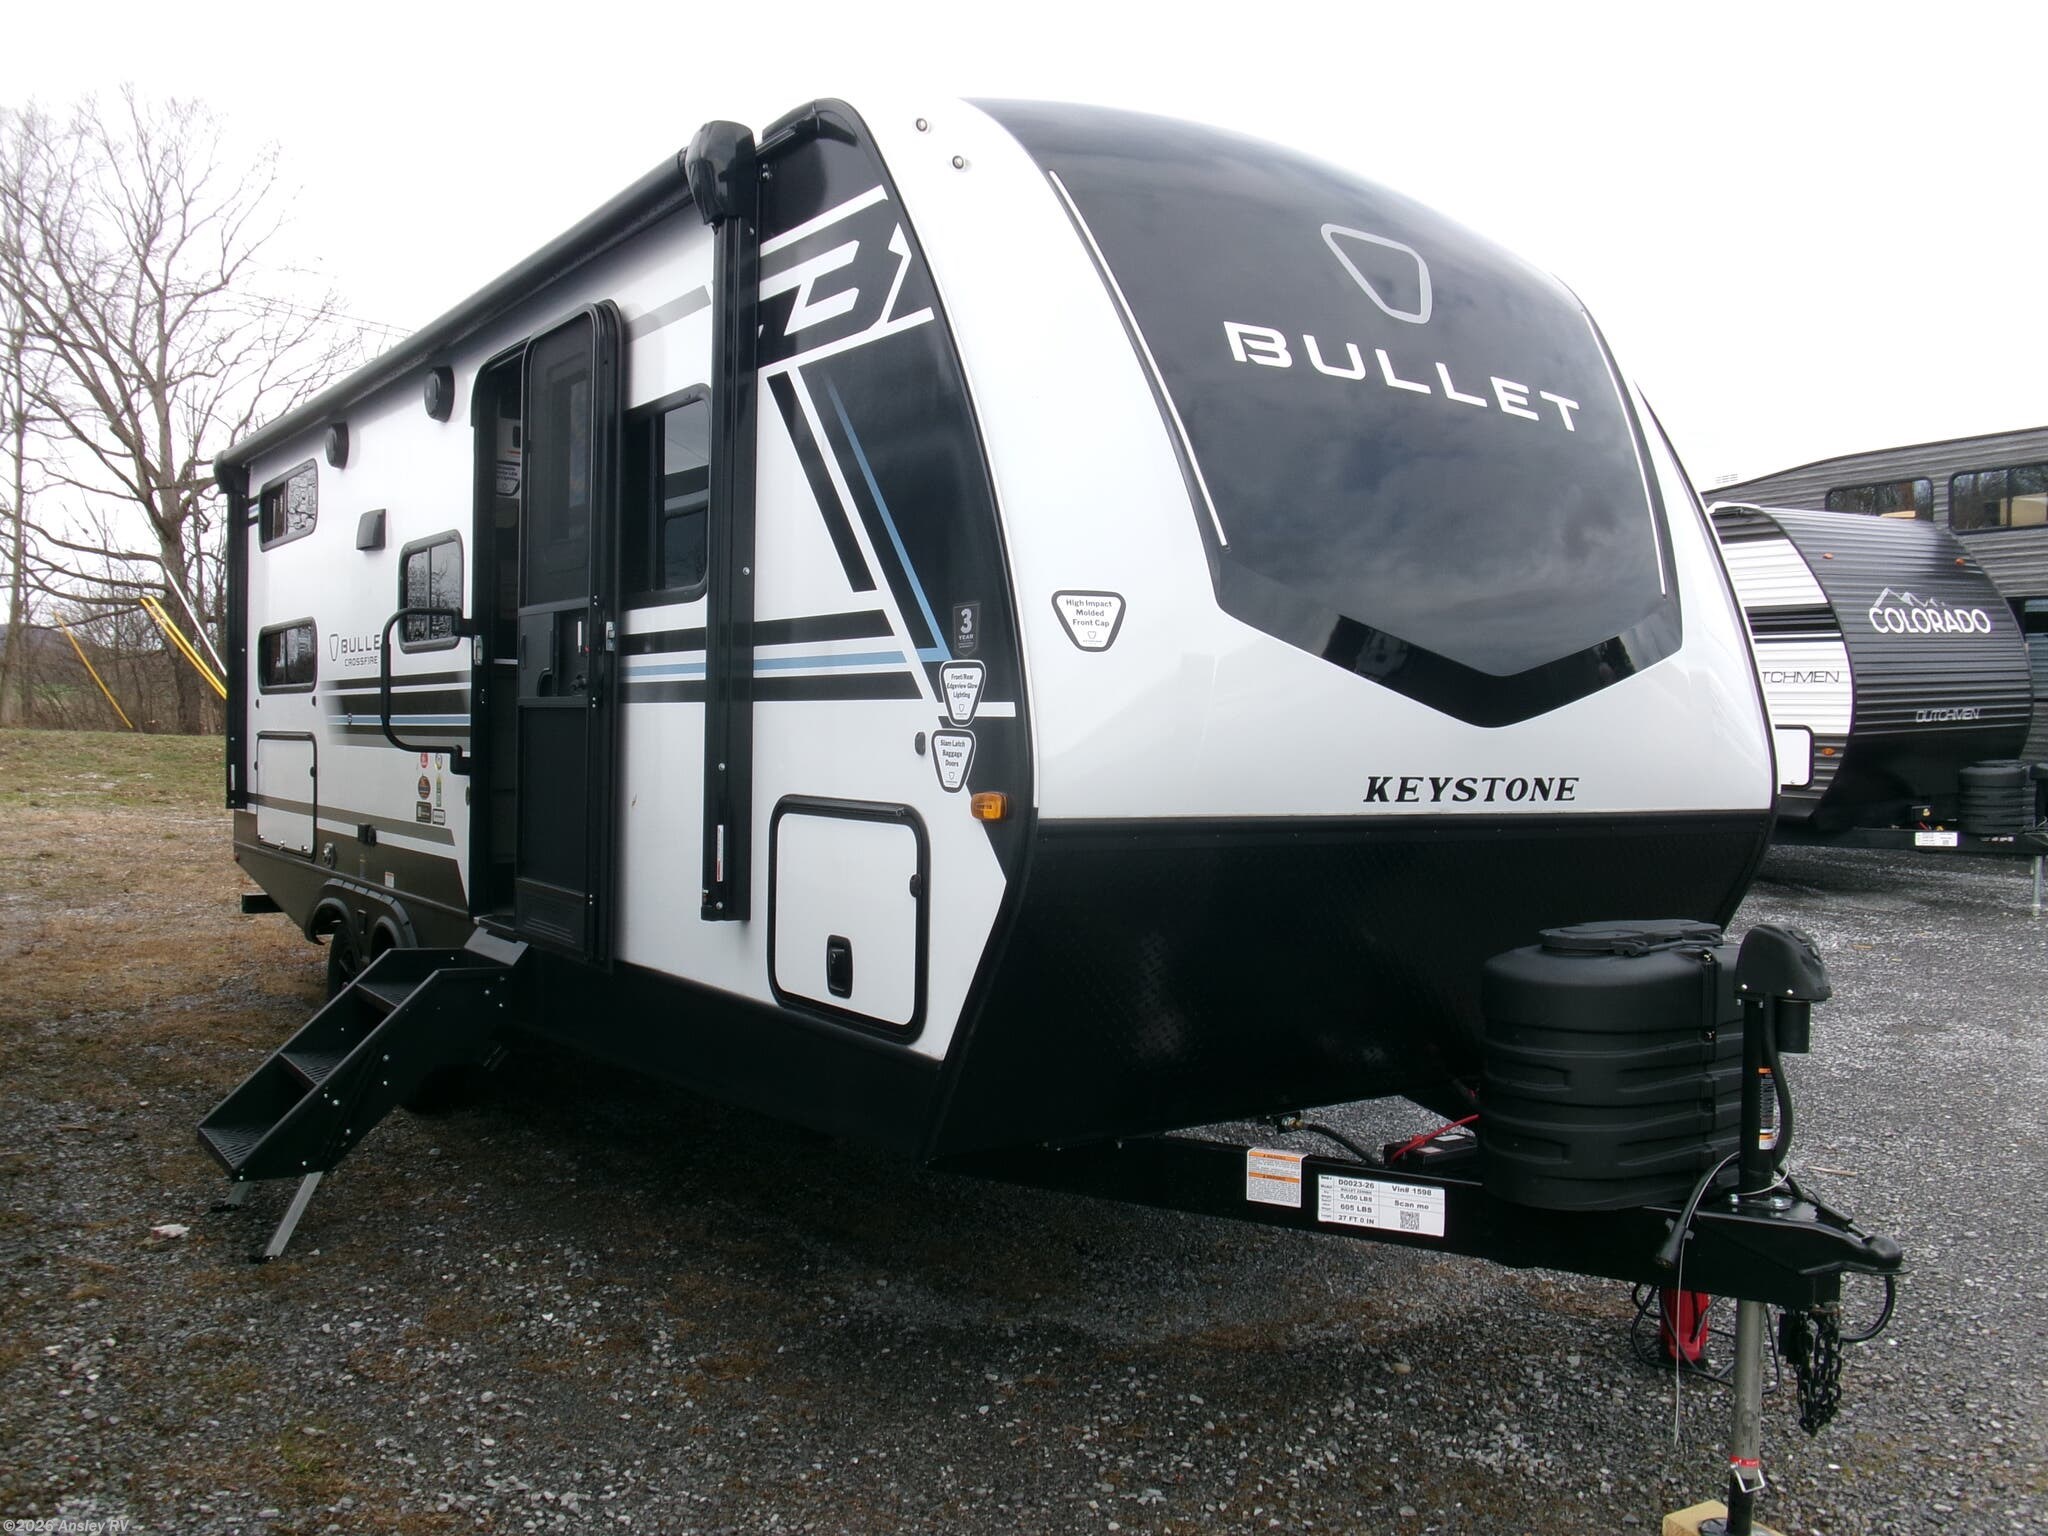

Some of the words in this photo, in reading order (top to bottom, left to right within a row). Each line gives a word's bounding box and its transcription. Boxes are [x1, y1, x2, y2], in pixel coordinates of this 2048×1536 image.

[1223, 321, 1580, 432] BULLET
[1066, 599, 1084, 608] High
[1086, 599, 1112, 608] Impact
[1075, 609, 1105, 617] Molded
[960, 608, 973, 634] 3
[1072, 618, 1093, 626] Front
[1094, 619, 1110, 628] Cap
[1868, 607, 1992, 634] COLORADO
[957, 633, 974, 641] YEAR
[341, 634, 381, 654] BULLE
[344, 655, 378, 667] CROSSFIRE
[1762, 670, 1840, 684] TCHMEN
[952, 691, 971, 699] Lighting
[1915, 707, 1982, 723] DUTCHMEN
[940, 739, 951, 747] Slam
[952, 740, 966, 748] Latch
[942, 749, 963, 759] Baggage
[945, 759, 959, 767] Doors
[1363, 775, 1580, 803] KEYSTONE
[1391, 1185, 1410, 1193] Vin#
[1394, 1199, 1415, 1208] Scan
[1356, 1205, 1373, 1213] LBS
